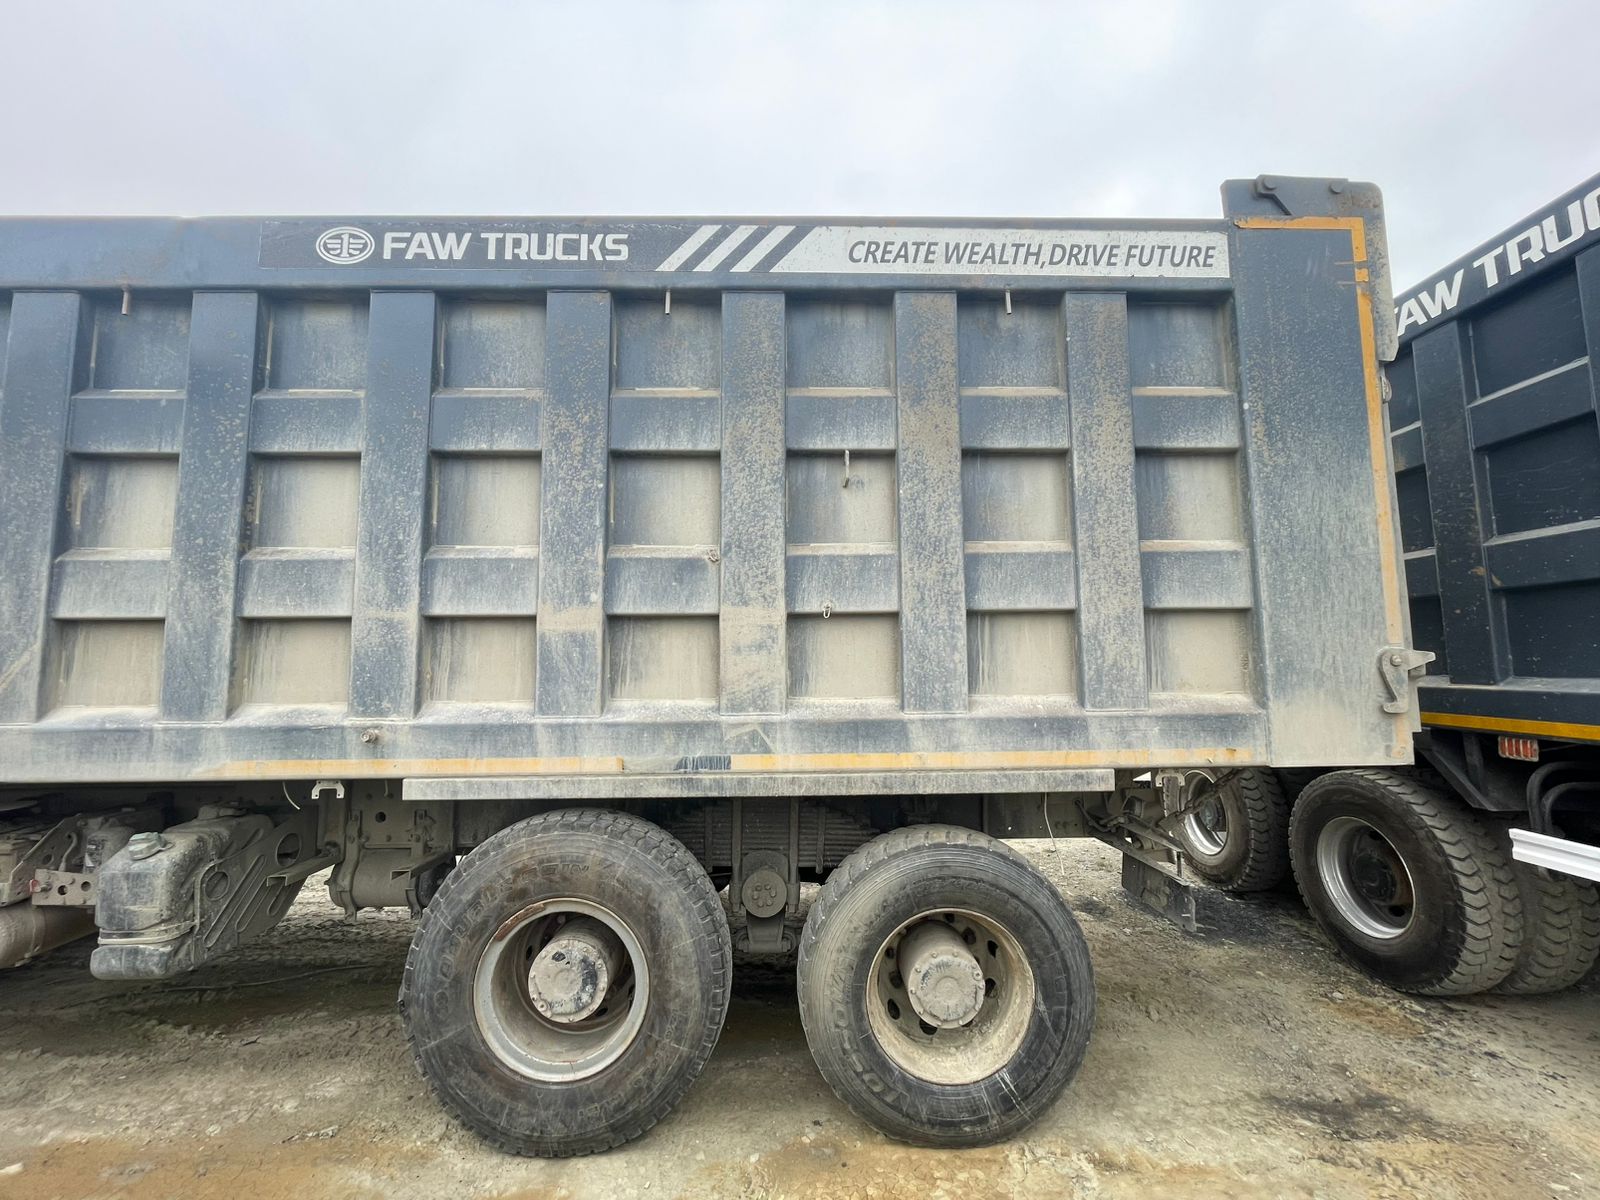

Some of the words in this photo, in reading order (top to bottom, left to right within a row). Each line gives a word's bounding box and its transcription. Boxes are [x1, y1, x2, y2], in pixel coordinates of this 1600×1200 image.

[383, 232, 471, 260] FAW
[480, 232, 630, 261] TRUCKS
[848, 240, 938, 265] CREATE
[1125, 244, 1216, 268] FUTURE
[1394, 268, 1464, 337] AW
